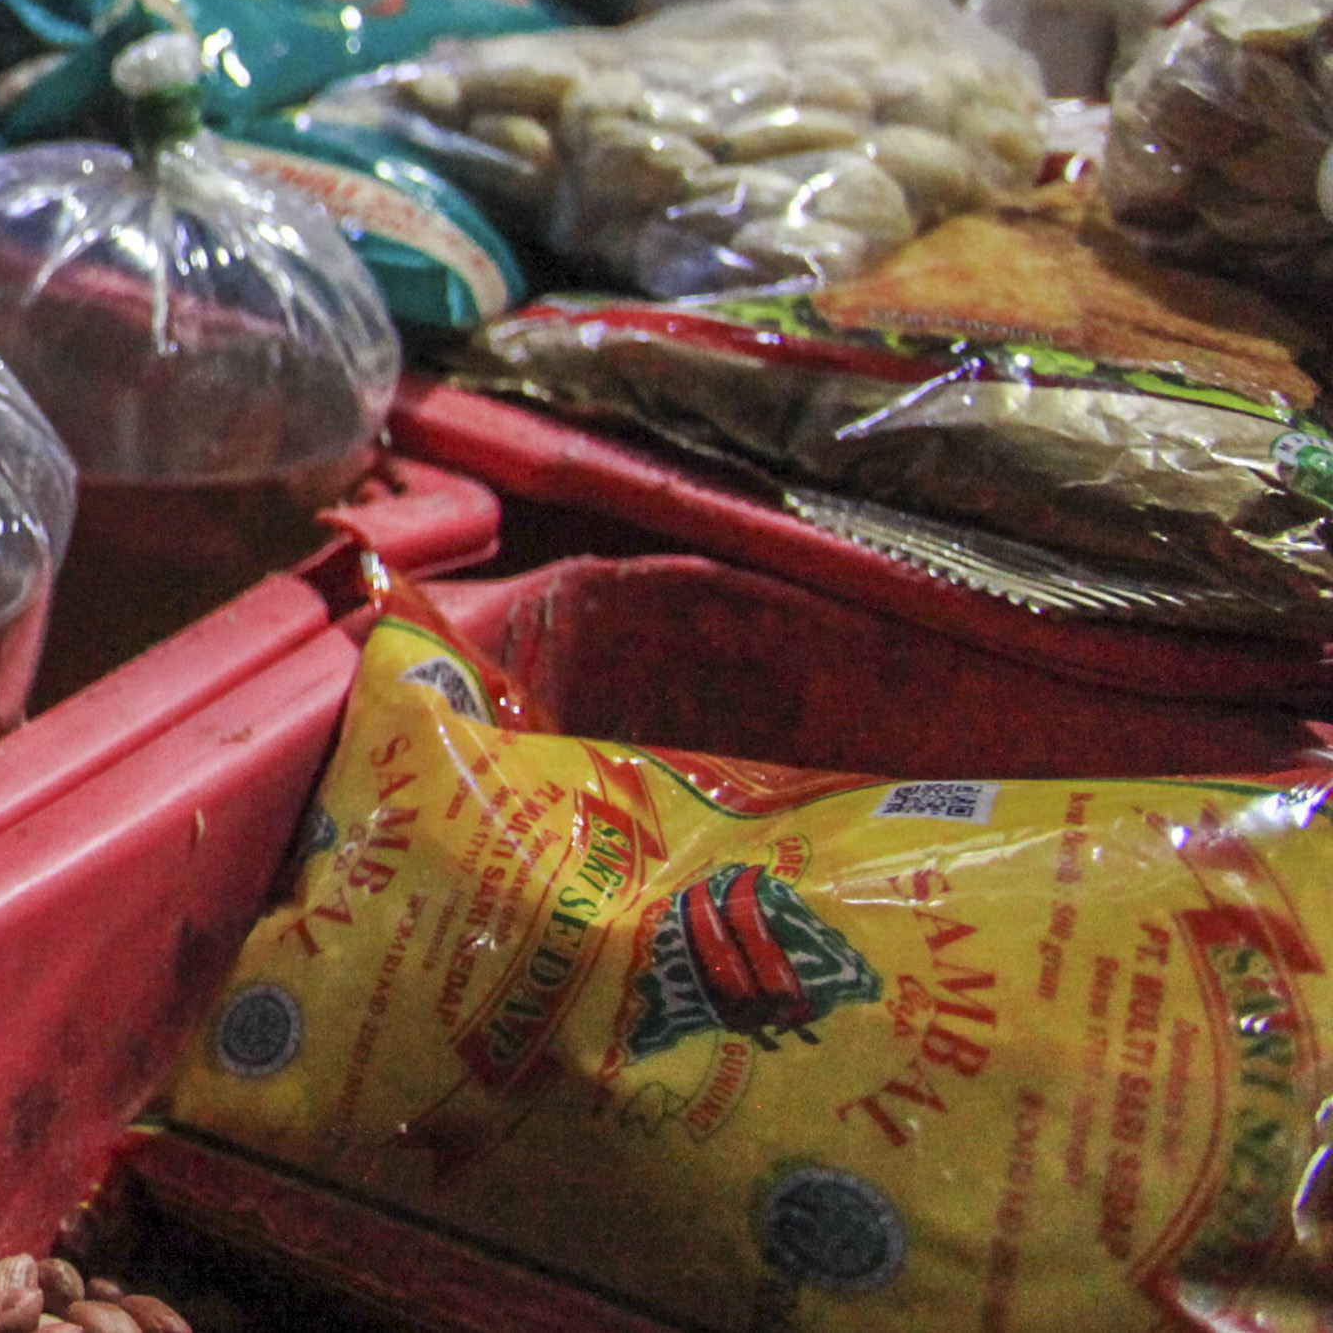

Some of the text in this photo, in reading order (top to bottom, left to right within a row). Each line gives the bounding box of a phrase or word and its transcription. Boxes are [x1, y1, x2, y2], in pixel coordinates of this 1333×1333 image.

[278, 734, 420, 958] SAMBAL
[490, 797, 549, 859] MULTI
[775, 835, 805, 880] CABE
[464, 865, 506, 927] SARI
[436, 930, 479, 1027] SEDAP
[488, 886, 600, 1062] SEDAP
[835, 869, 997, 1148] SAMBAL
